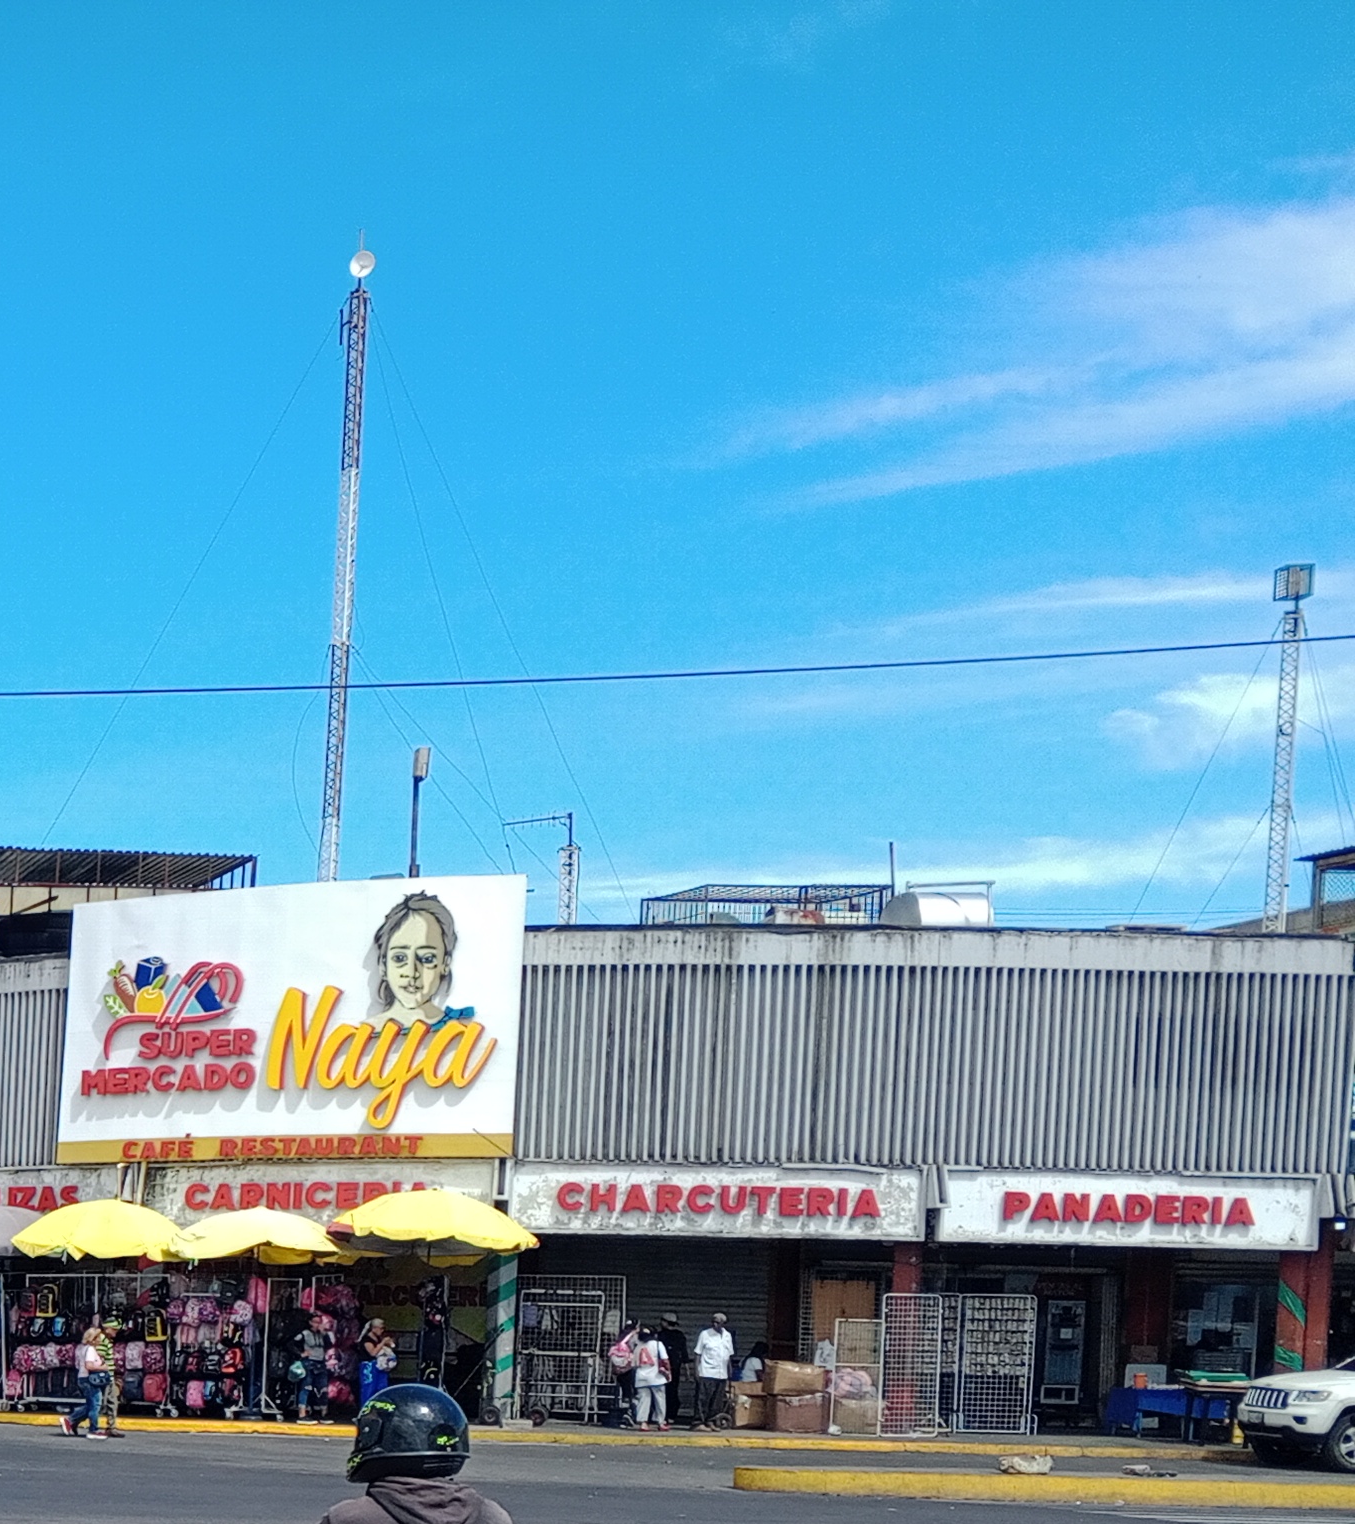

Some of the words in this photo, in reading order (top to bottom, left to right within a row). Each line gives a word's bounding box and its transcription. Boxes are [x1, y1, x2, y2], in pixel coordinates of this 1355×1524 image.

[139, 1028, 257, 1060] SUPER
[267, 985, 497, 1129] Naya
[81, 1061, 257, 1097] MERCADO
[122, 1133, 194, 1159] CAFÉ
[219, 1135, 423, 1157] RESTAURANT
[556, 1182, 882, 1218] CHARCUTERIA
[1003, 1191, 1256, 1226] PANADERIA
